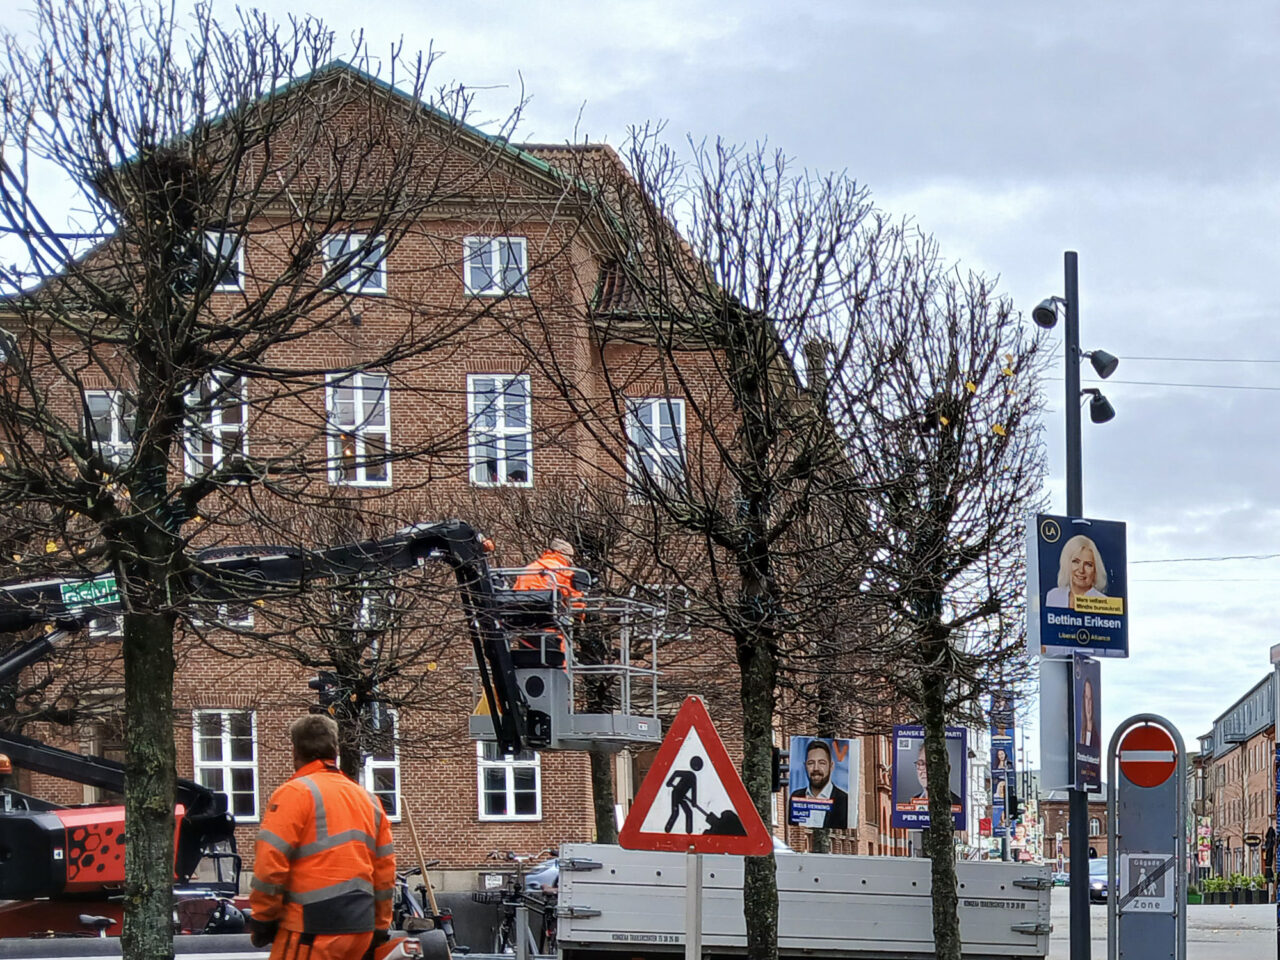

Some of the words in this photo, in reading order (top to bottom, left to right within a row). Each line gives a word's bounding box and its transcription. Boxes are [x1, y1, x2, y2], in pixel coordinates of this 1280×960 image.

[1047, 613, 1082, 626] Bettina
[1084, 616, 1121, 629] Eriksen
[1133, 899, 1161, 909] Zone
